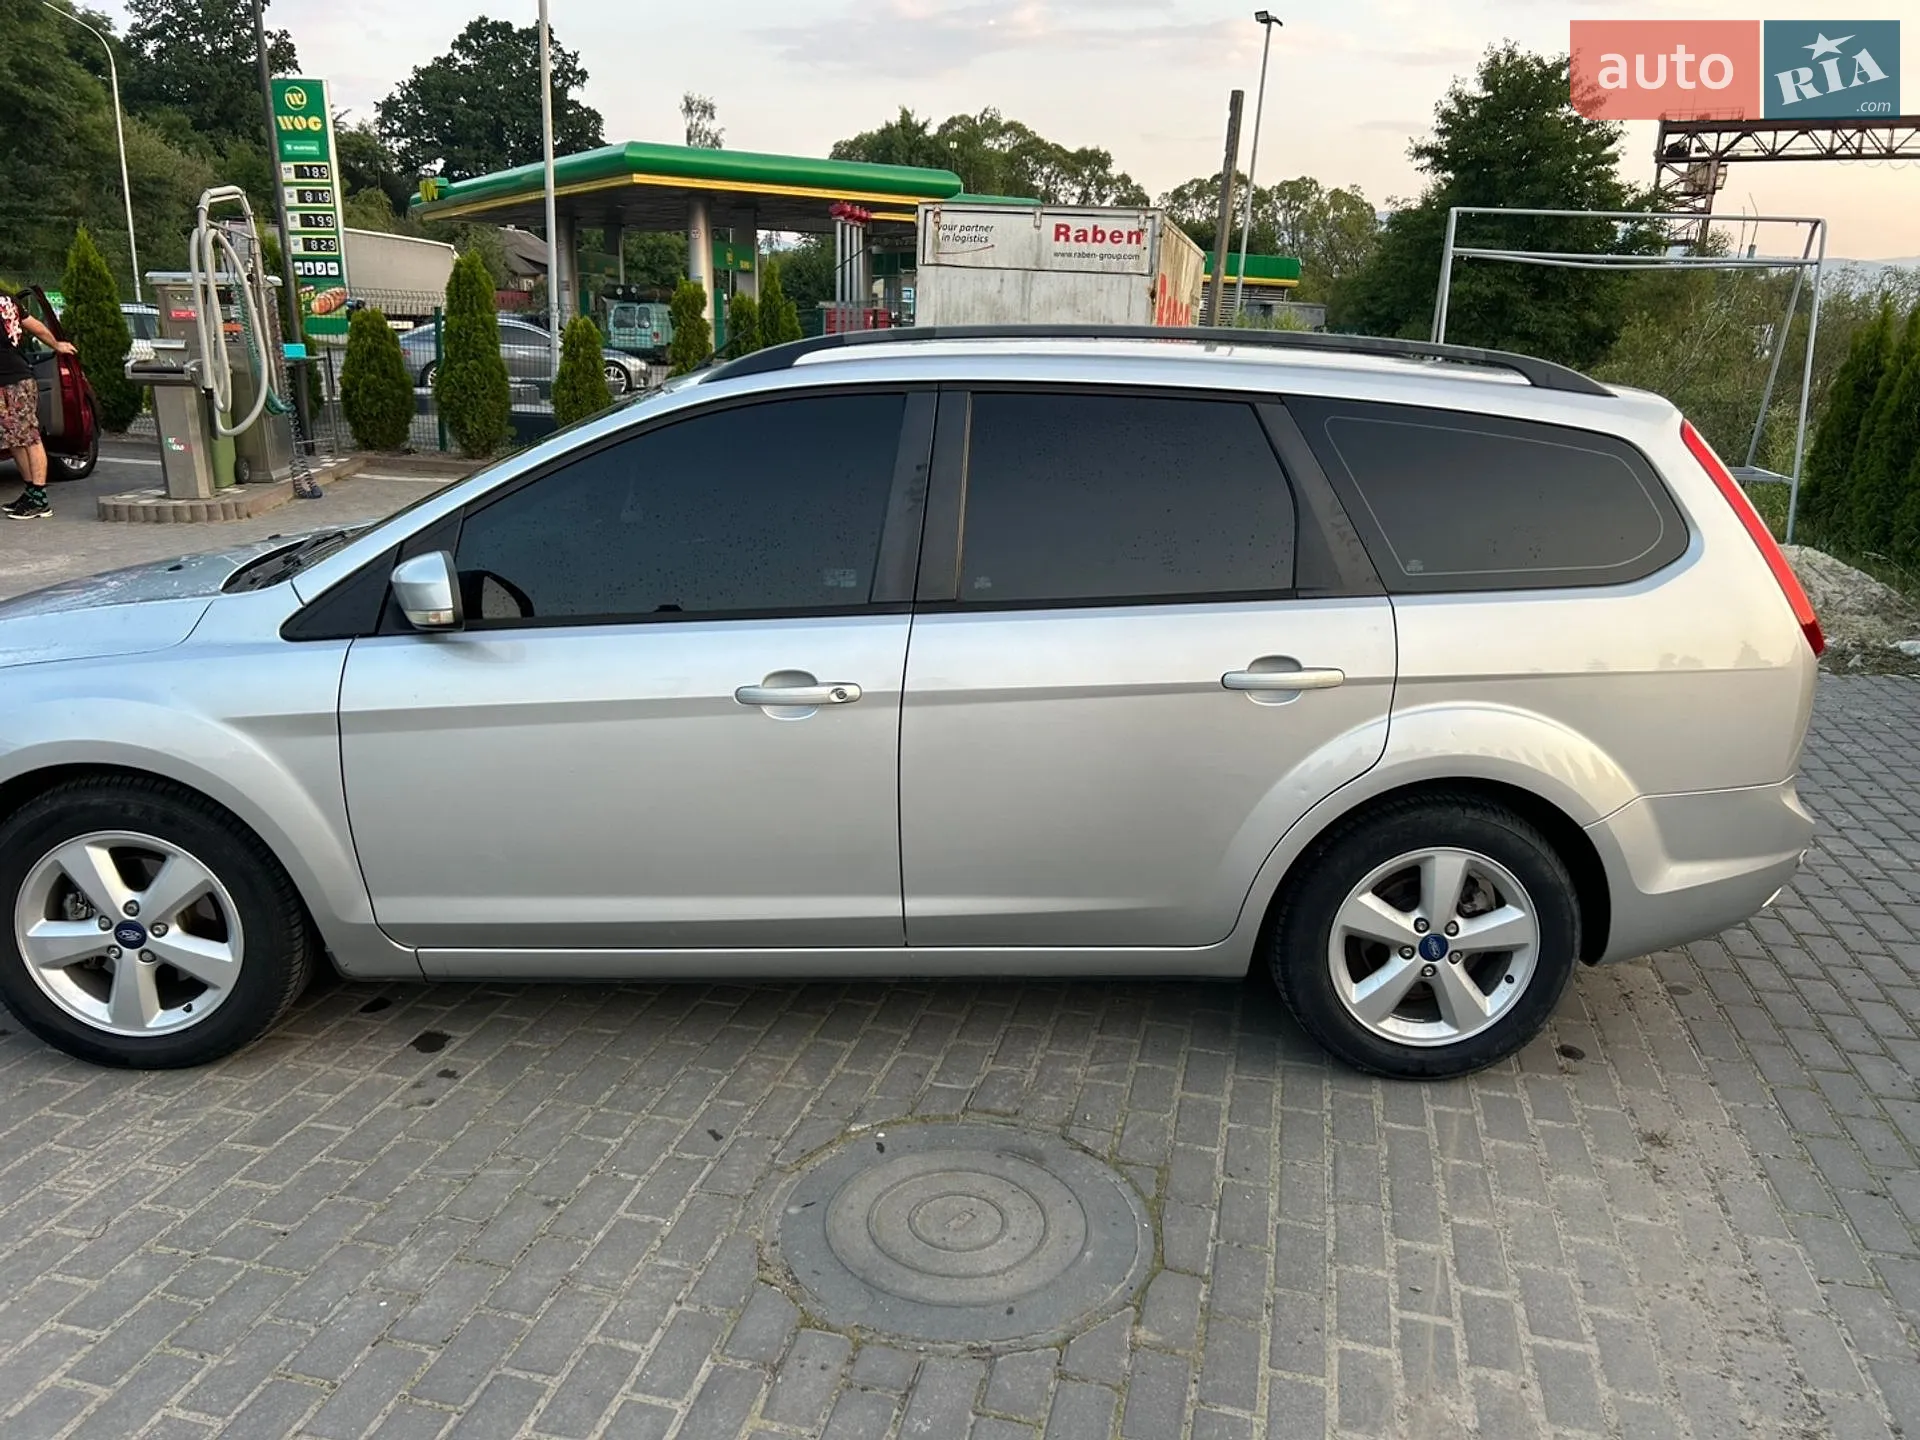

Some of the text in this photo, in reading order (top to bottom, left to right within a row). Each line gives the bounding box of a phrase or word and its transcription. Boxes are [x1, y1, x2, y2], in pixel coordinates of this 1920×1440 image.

[276, 115, 322, 131] WOG
[959, 223, 994, 233] partner
[942, 233, 988, 243] in logistics
[1054, 223, 1142, 245] Raben
[1053, 250, 1140, 260] www.raben-group.com
